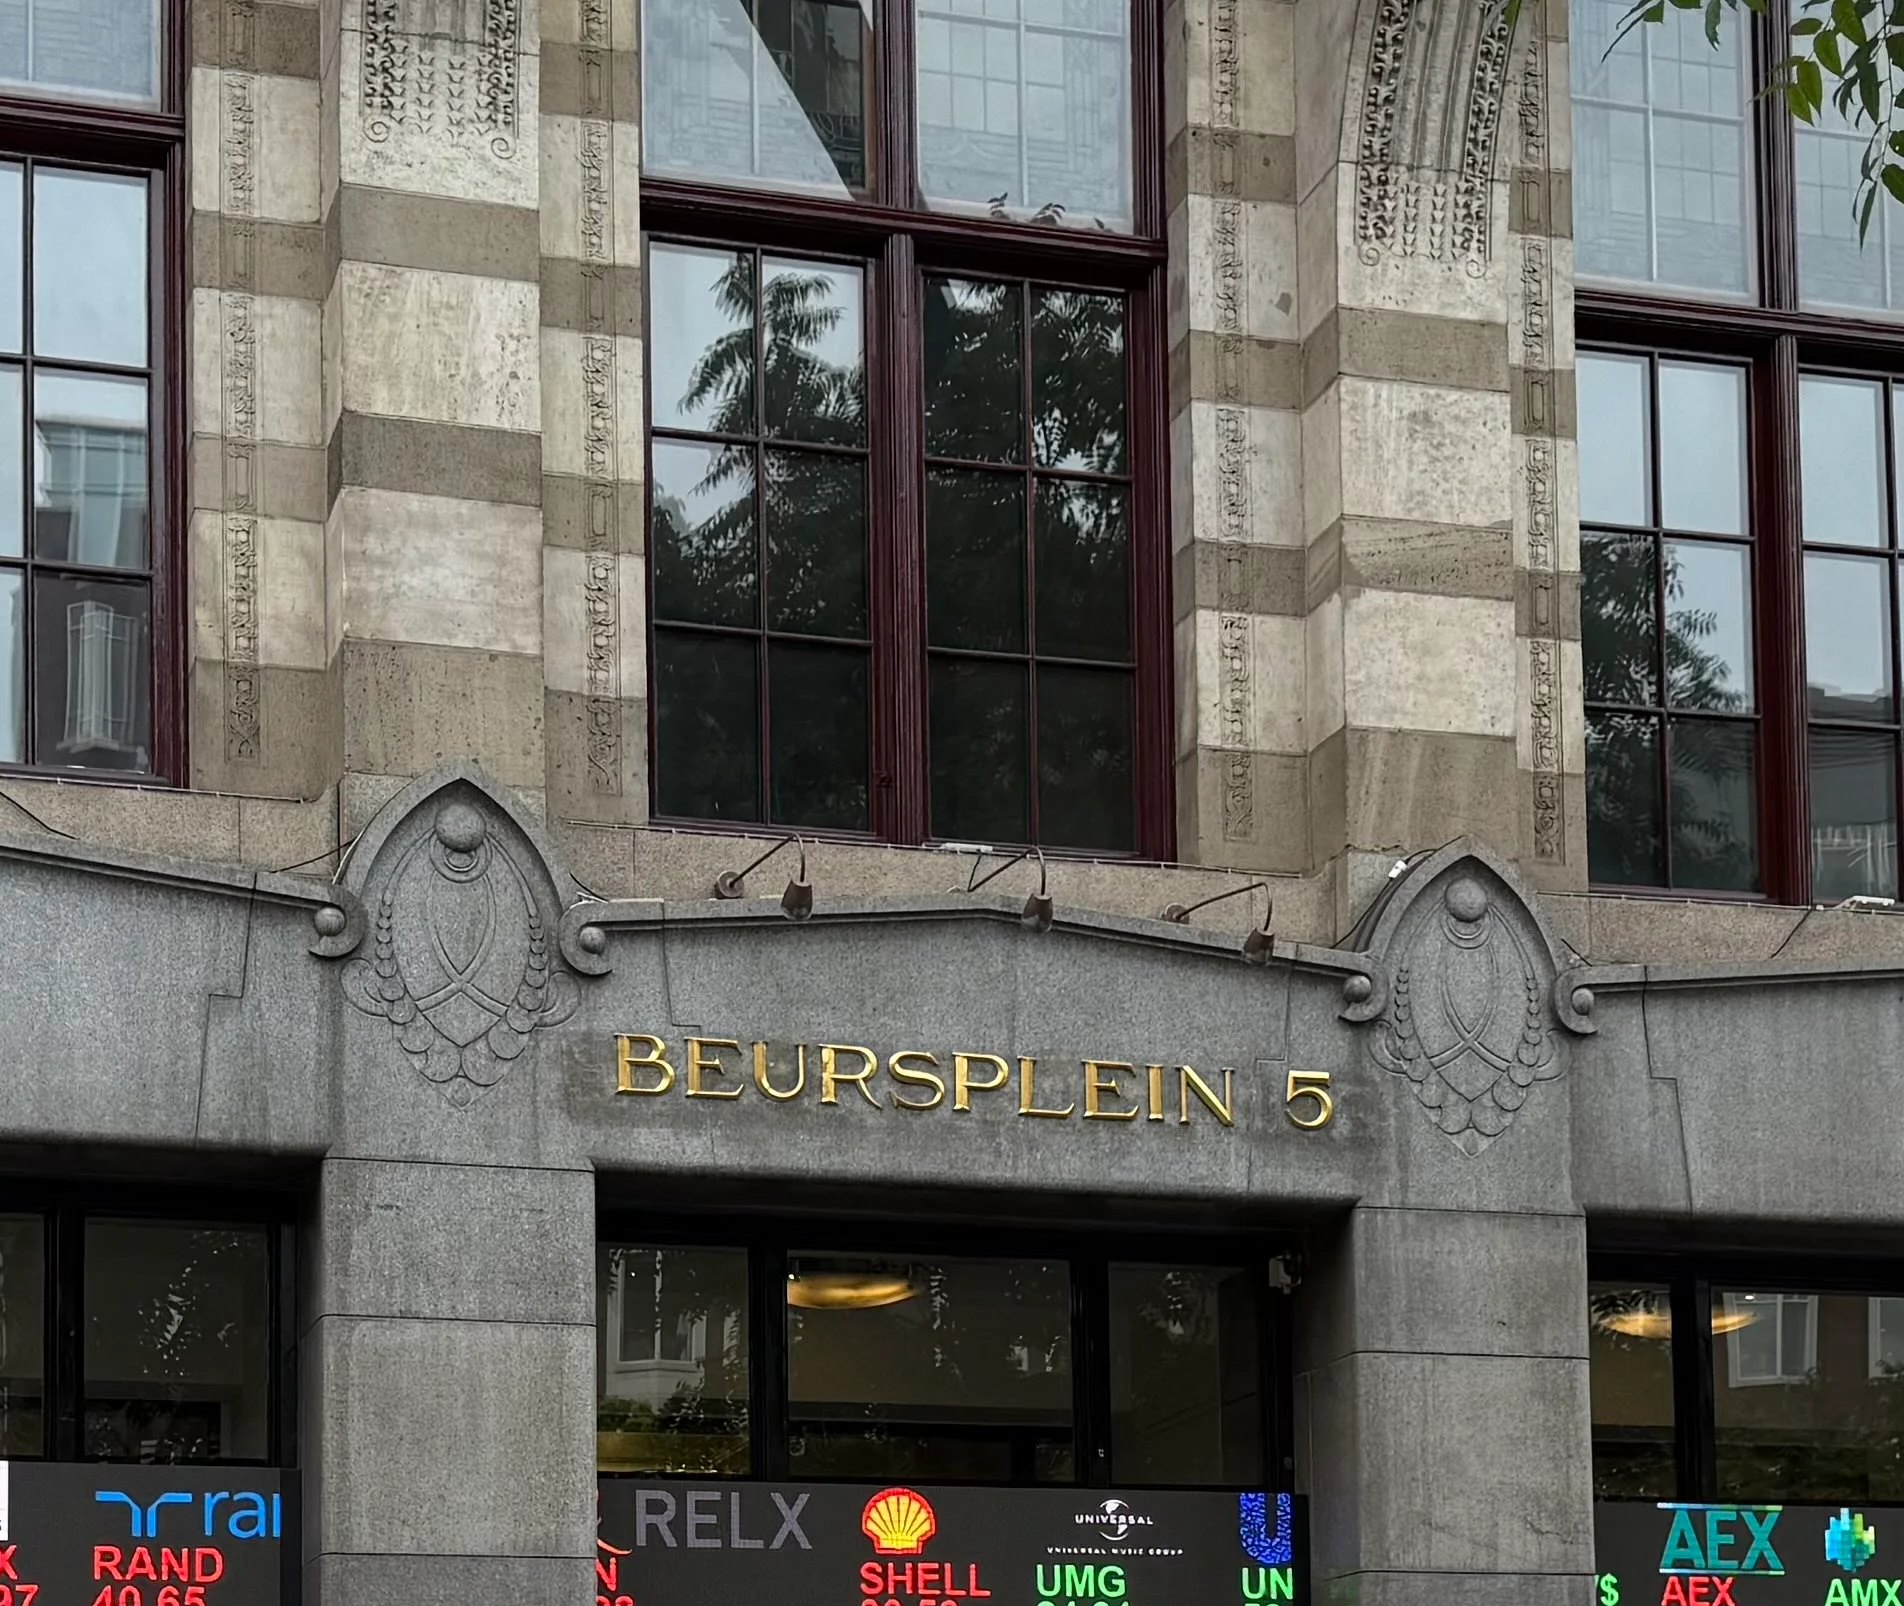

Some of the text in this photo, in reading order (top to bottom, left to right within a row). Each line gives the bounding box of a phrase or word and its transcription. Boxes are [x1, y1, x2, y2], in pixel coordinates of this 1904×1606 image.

[613, 1032, 1335, 1130] BEURSPLEIN 5
[635, 1489, 812, 1550] RELX
[1075, 1514, 1154, 1525] UNIVERSAL
[1660, 1510, 1784, 1570] AEX
[93, 1546, 224, 1583] RAND
[860, 1562, 991, 1597] SHELL
[1036, 1564, 1126, 1597] UMG
